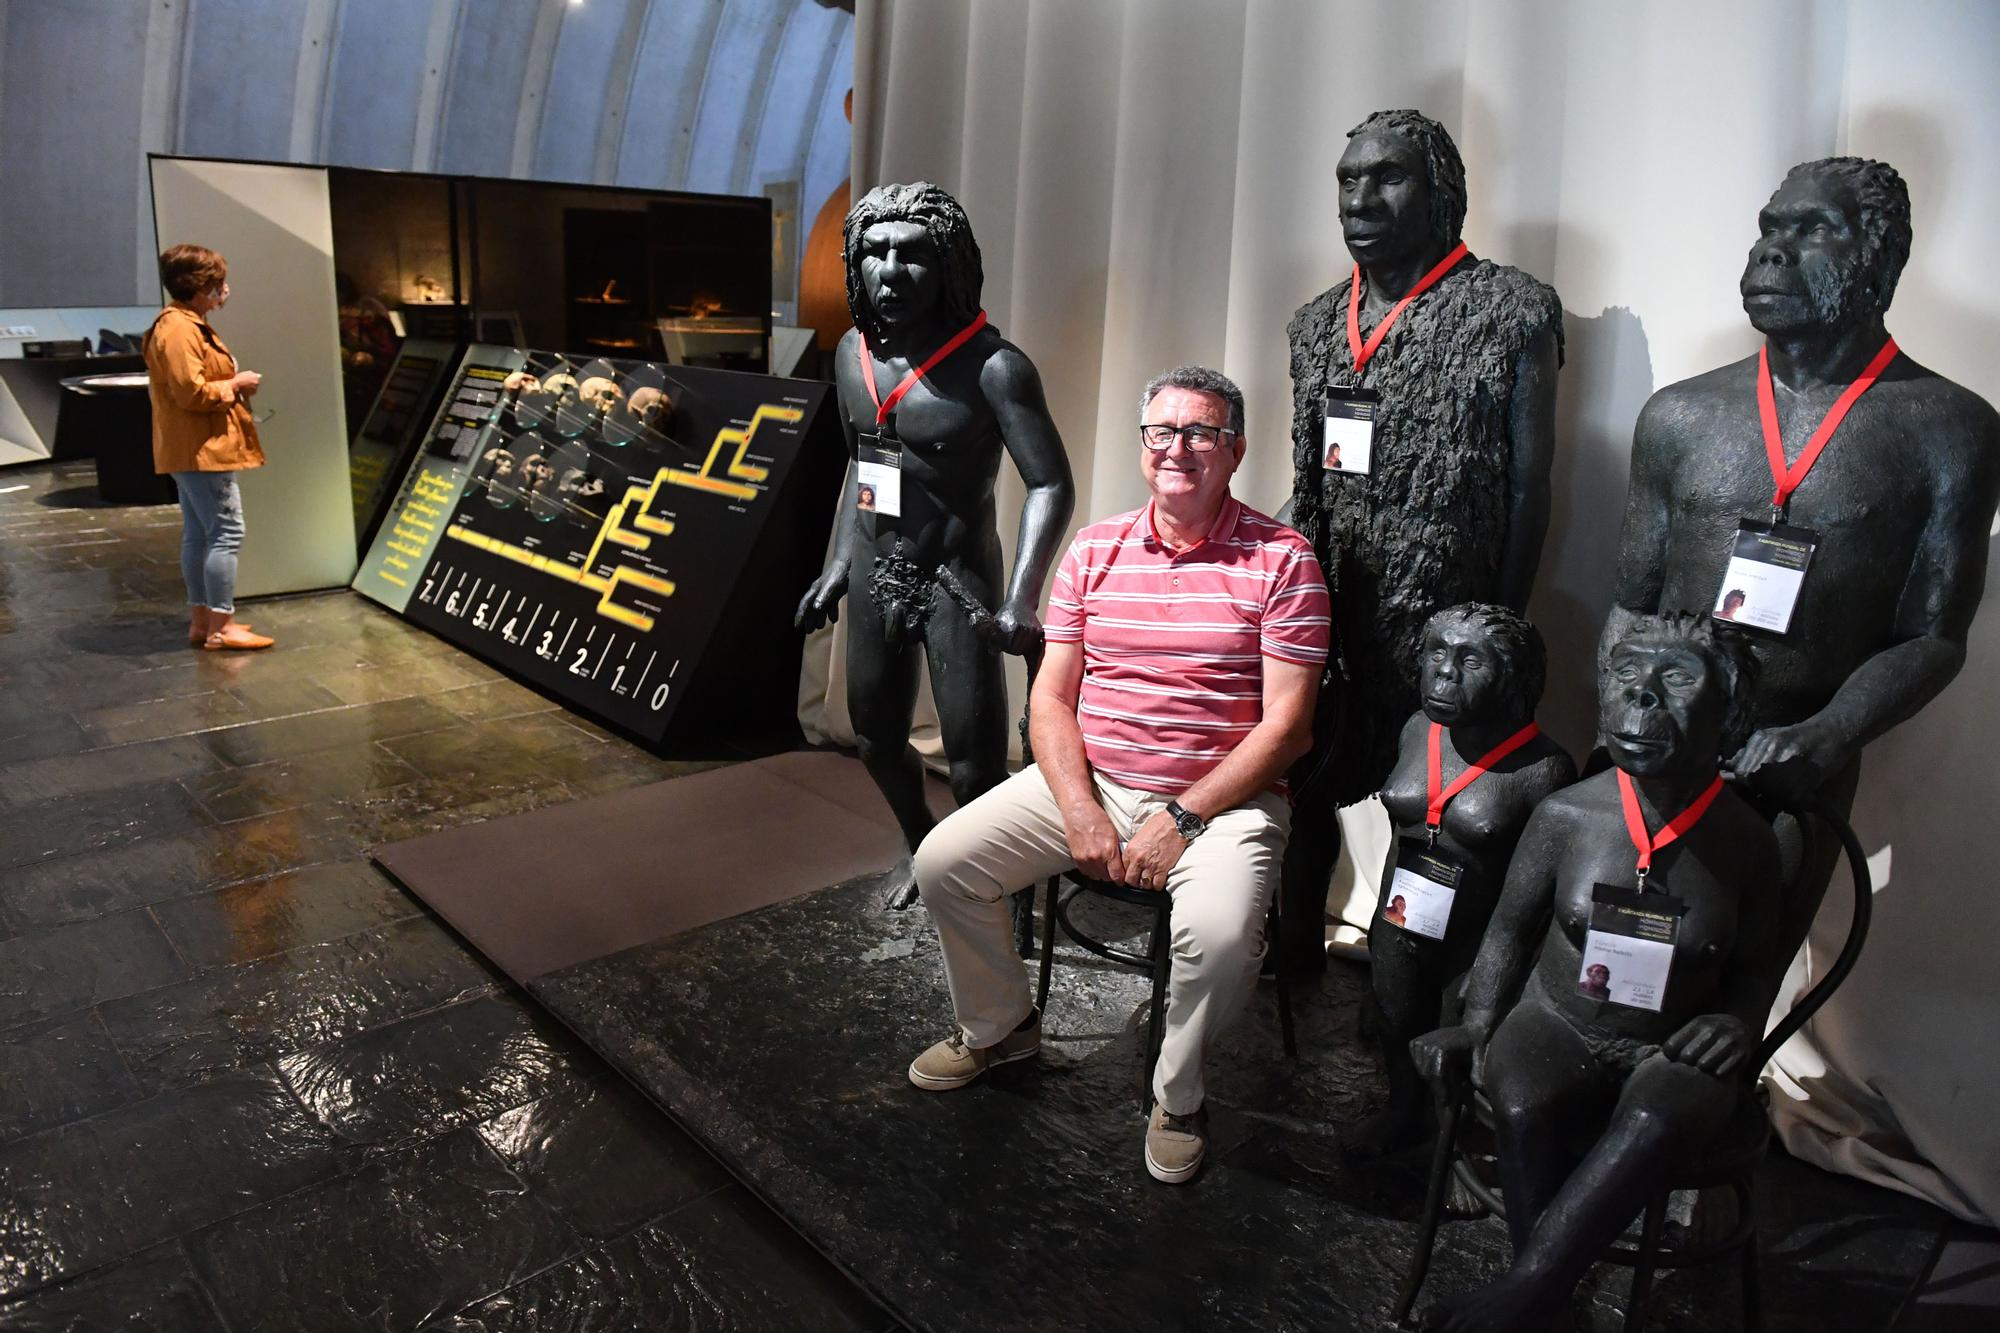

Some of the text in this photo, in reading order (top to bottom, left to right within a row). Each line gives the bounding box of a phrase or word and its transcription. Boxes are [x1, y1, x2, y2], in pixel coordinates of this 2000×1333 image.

[419, 579, 435, 600] 7
[445, 591, 461, 614] 6
[472, 603, 489, 627] 5
[501, 617, 518, 641] 4
[536, 631, 553, 655] 3
[569, 648, 588, 674] 2
[611, 665, 626, 691] 1
[650, 683, 669, 711] 0
